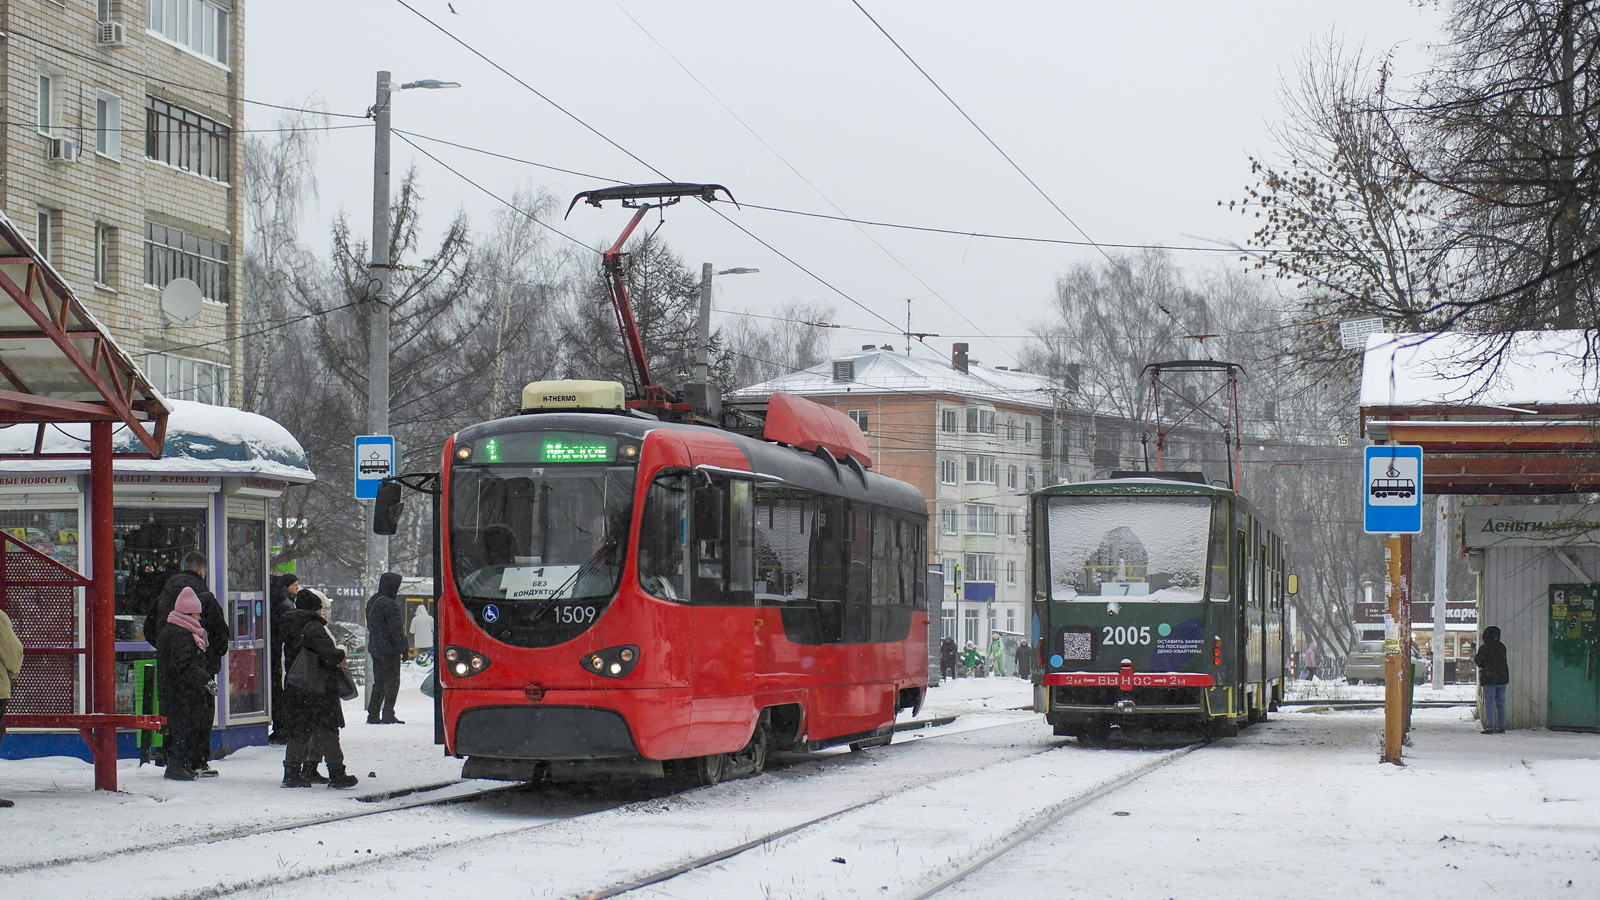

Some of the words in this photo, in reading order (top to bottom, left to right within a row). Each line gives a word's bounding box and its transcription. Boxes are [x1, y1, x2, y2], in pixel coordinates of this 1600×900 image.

[1339, 436, 1348, 445] 15
[486, 439, 497, 460] 1
[20, 476, 67, 485] НОВОСТИ
[113, 475, 151, 483] ГАЗЕТЫ
[159, 475, 210, 484] ЖУРНАЛЫ
[1480, 518, 1544, 533] Деньги
[533, 567, 545, 578] 1
[1119, 584, 1130, 596] 7
[554, 606, 596, 624] 1509
[1102, 626, 1151, 645] 2005
[1098, 676, 1151, 685] ВЫНОС
